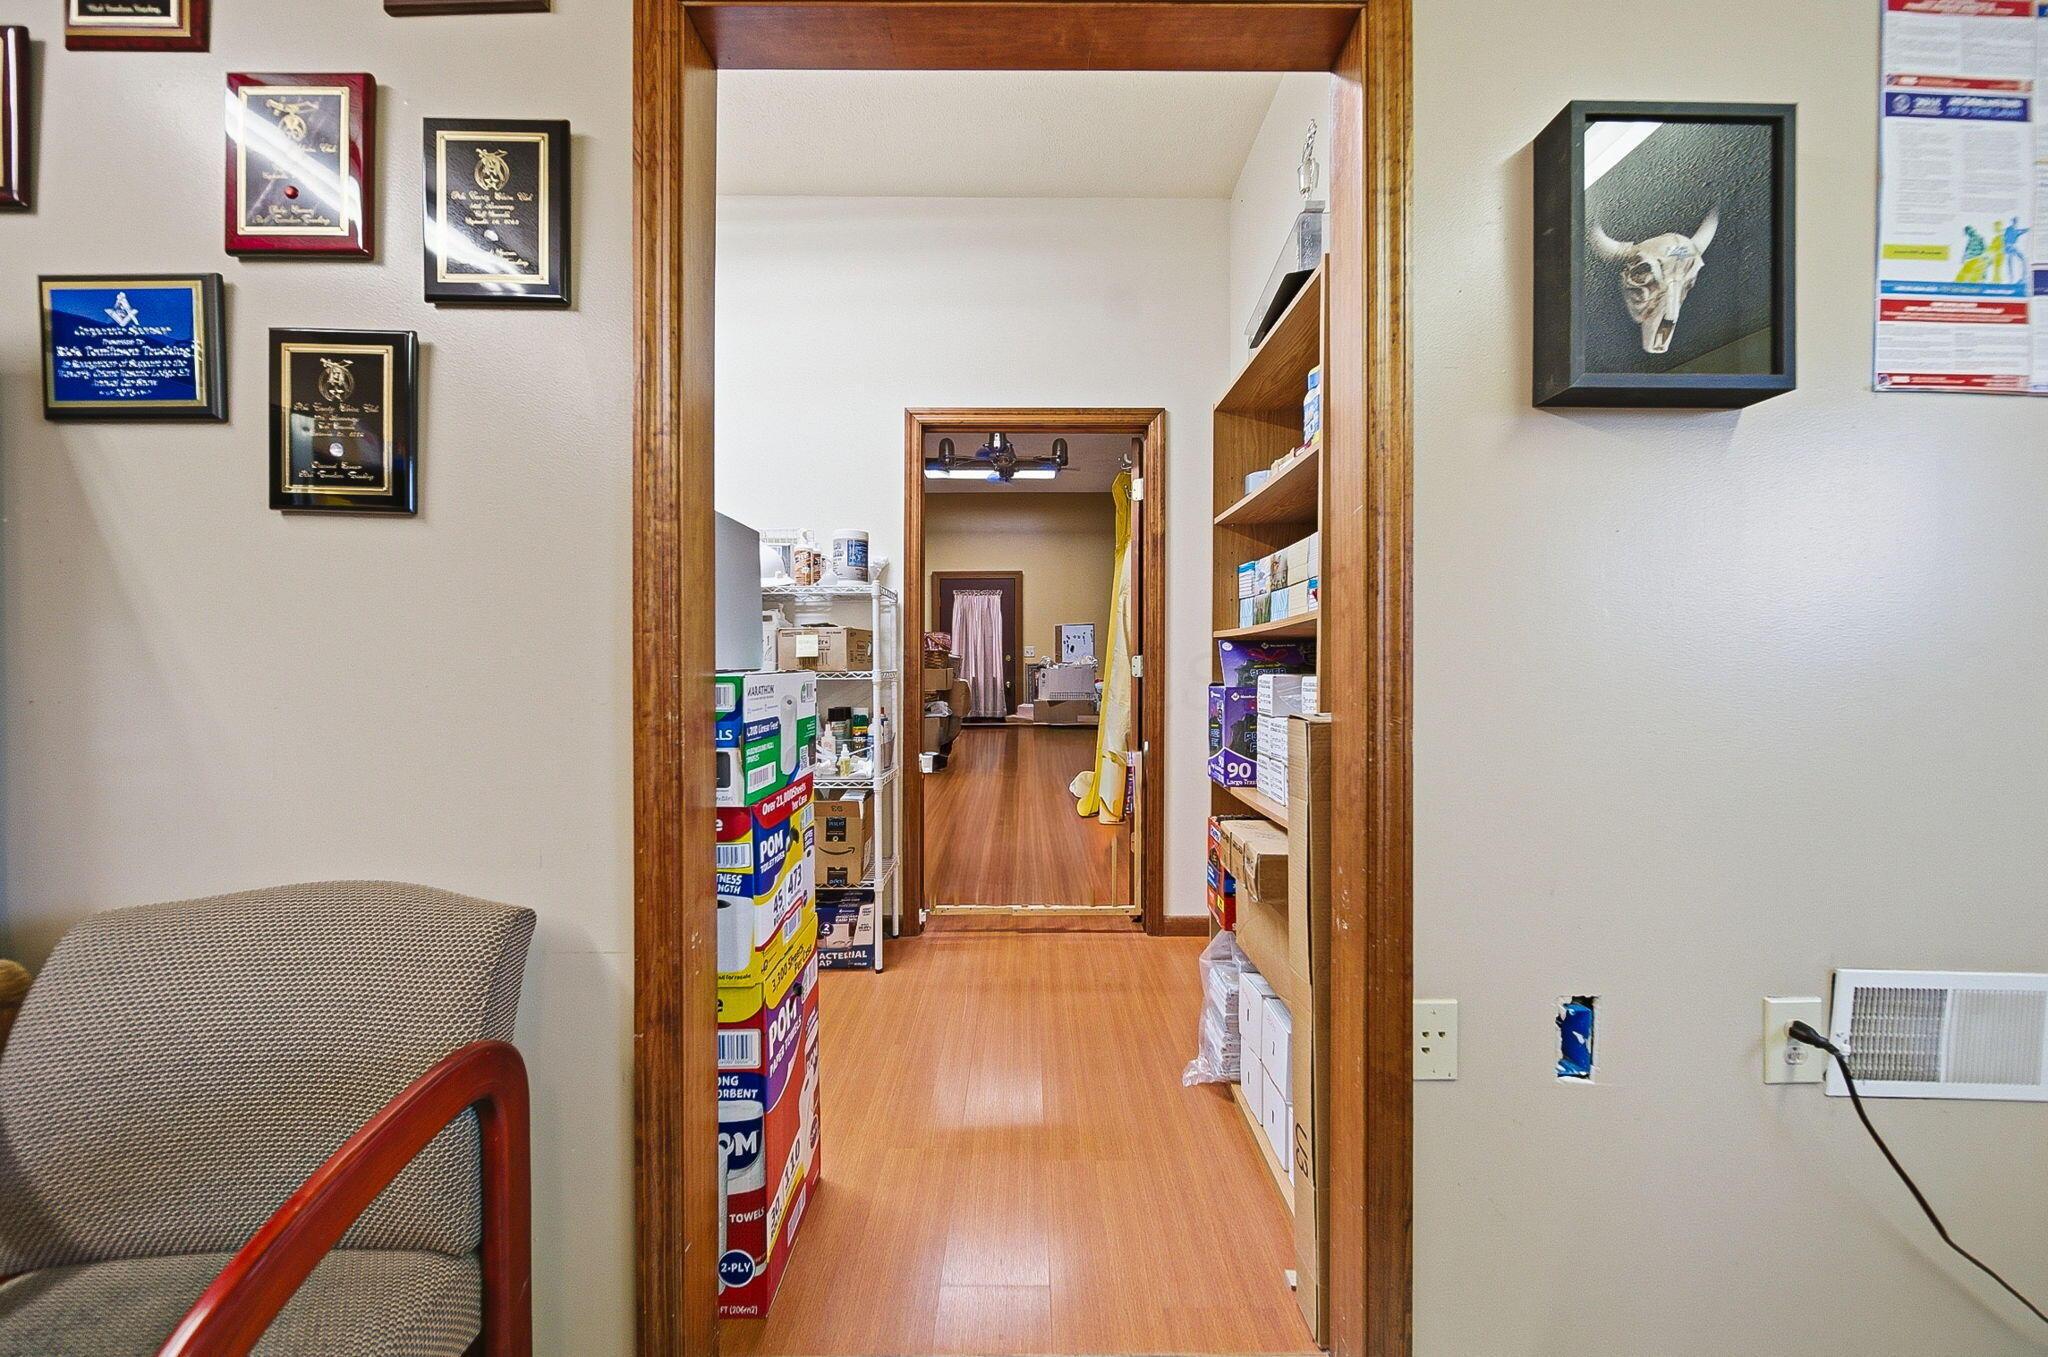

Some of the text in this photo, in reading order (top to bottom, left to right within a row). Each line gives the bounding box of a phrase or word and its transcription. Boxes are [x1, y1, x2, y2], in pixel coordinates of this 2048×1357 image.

[716, 729, 733, 740] LS
[1227, 762, 1252, 778] 90
[762, 801, 776, 816] Over
[760, 829, 784, 864] POM
[788, 863, 801, 894] 473
[773, 888, 783, 914] 45
[824, 923, 830, 931] 2
[729, 1206, 765, 1223] TOWELS
[720, 1305, 728, 1314] FT
